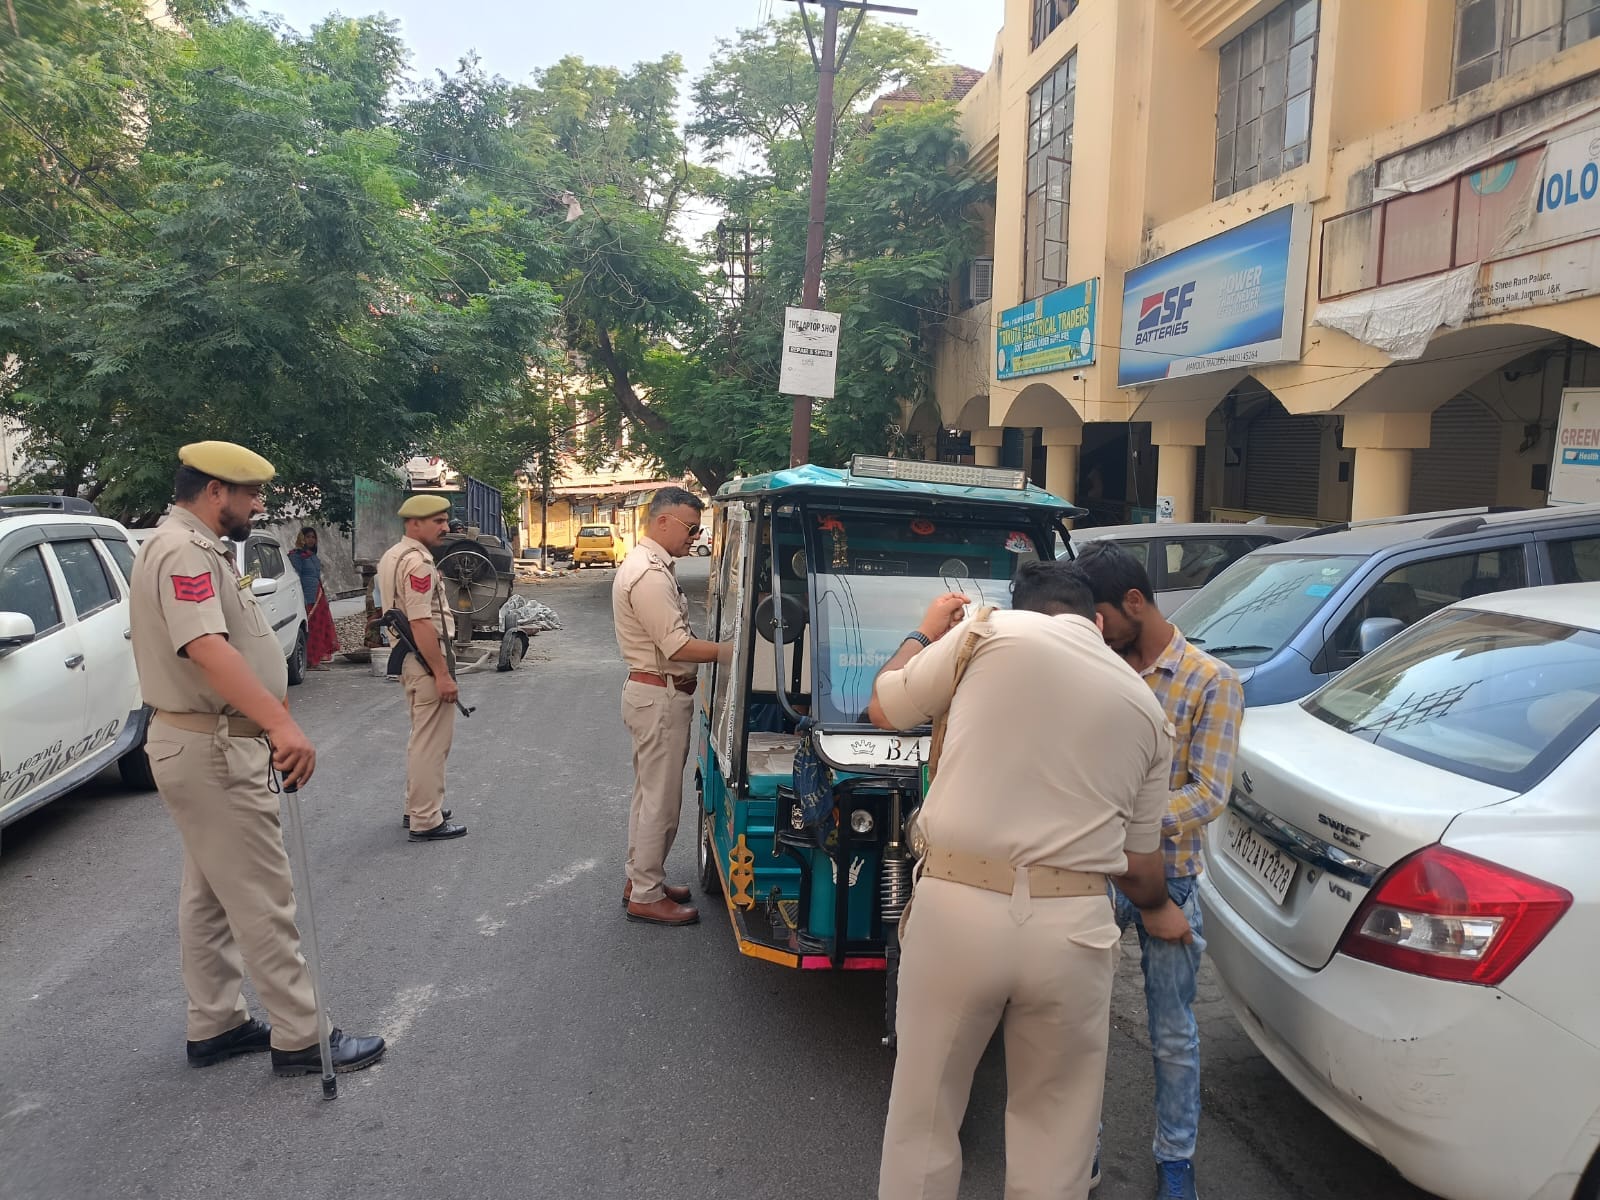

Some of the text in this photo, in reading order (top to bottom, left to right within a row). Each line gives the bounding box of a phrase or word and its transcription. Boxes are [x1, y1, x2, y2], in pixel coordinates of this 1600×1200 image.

[1513, 277, 1528, 287] Ram
[1160, 280, 1197, 325] SF
[799, 320, 821, 332] LAPTOP
[821, 323, 837, 334] SHOP
[1022, 315, 1057, 341] ELECTRICAL
[1058, 305, 1089, 332] TRADERS
[1135, 320, 1190, 346] BATTERIES
[1318, 813, 1371, 841] SWIFT
